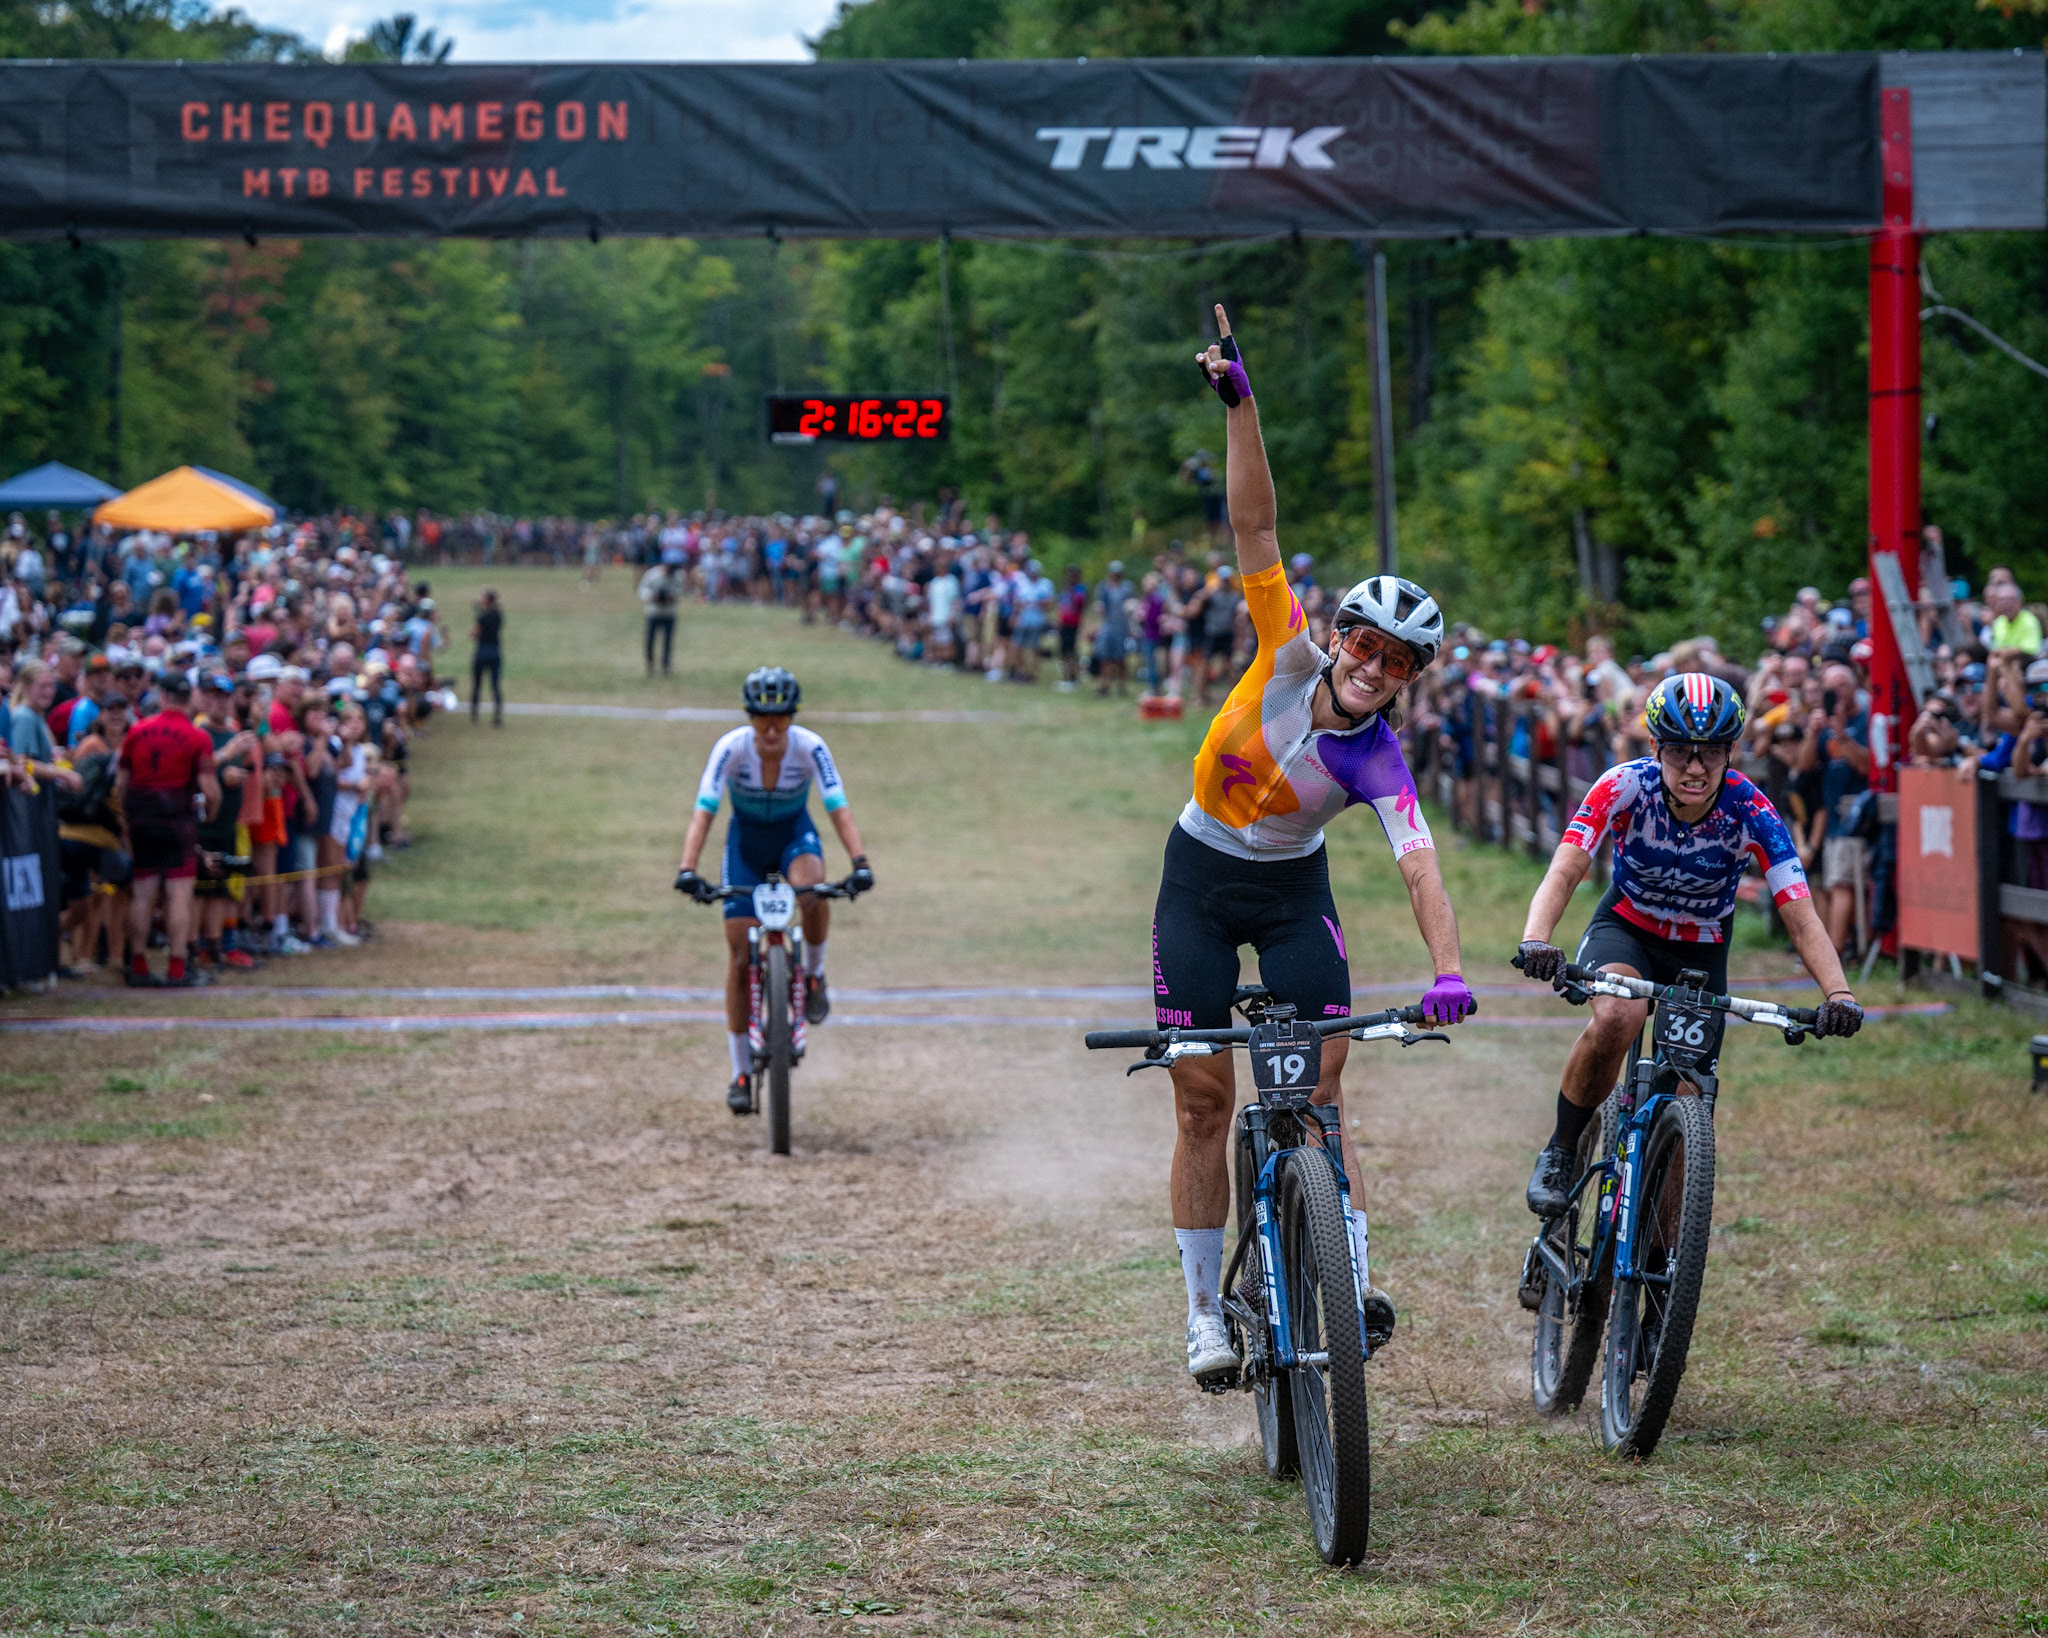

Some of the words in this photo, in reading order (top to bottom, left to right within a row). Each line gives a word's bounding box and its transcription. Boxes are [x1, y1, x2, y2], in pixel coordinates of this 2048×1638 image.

[181, 100, 629, 148] CHEQUAMEGON
[1036, 126, 1347, 170] TREK
[243, 167, 330, 198] MTB
[353, 166, 567, 198] FESTIVAL
[1623, 855, 1728, 889] SANTA
[1695, 855, 1728, 871] Rapha
[1623, 880, 1719, 909] SRAM
[1664, 1013, 1705, 1046] 36
[1266, 1053, 1306, 1086] 19
